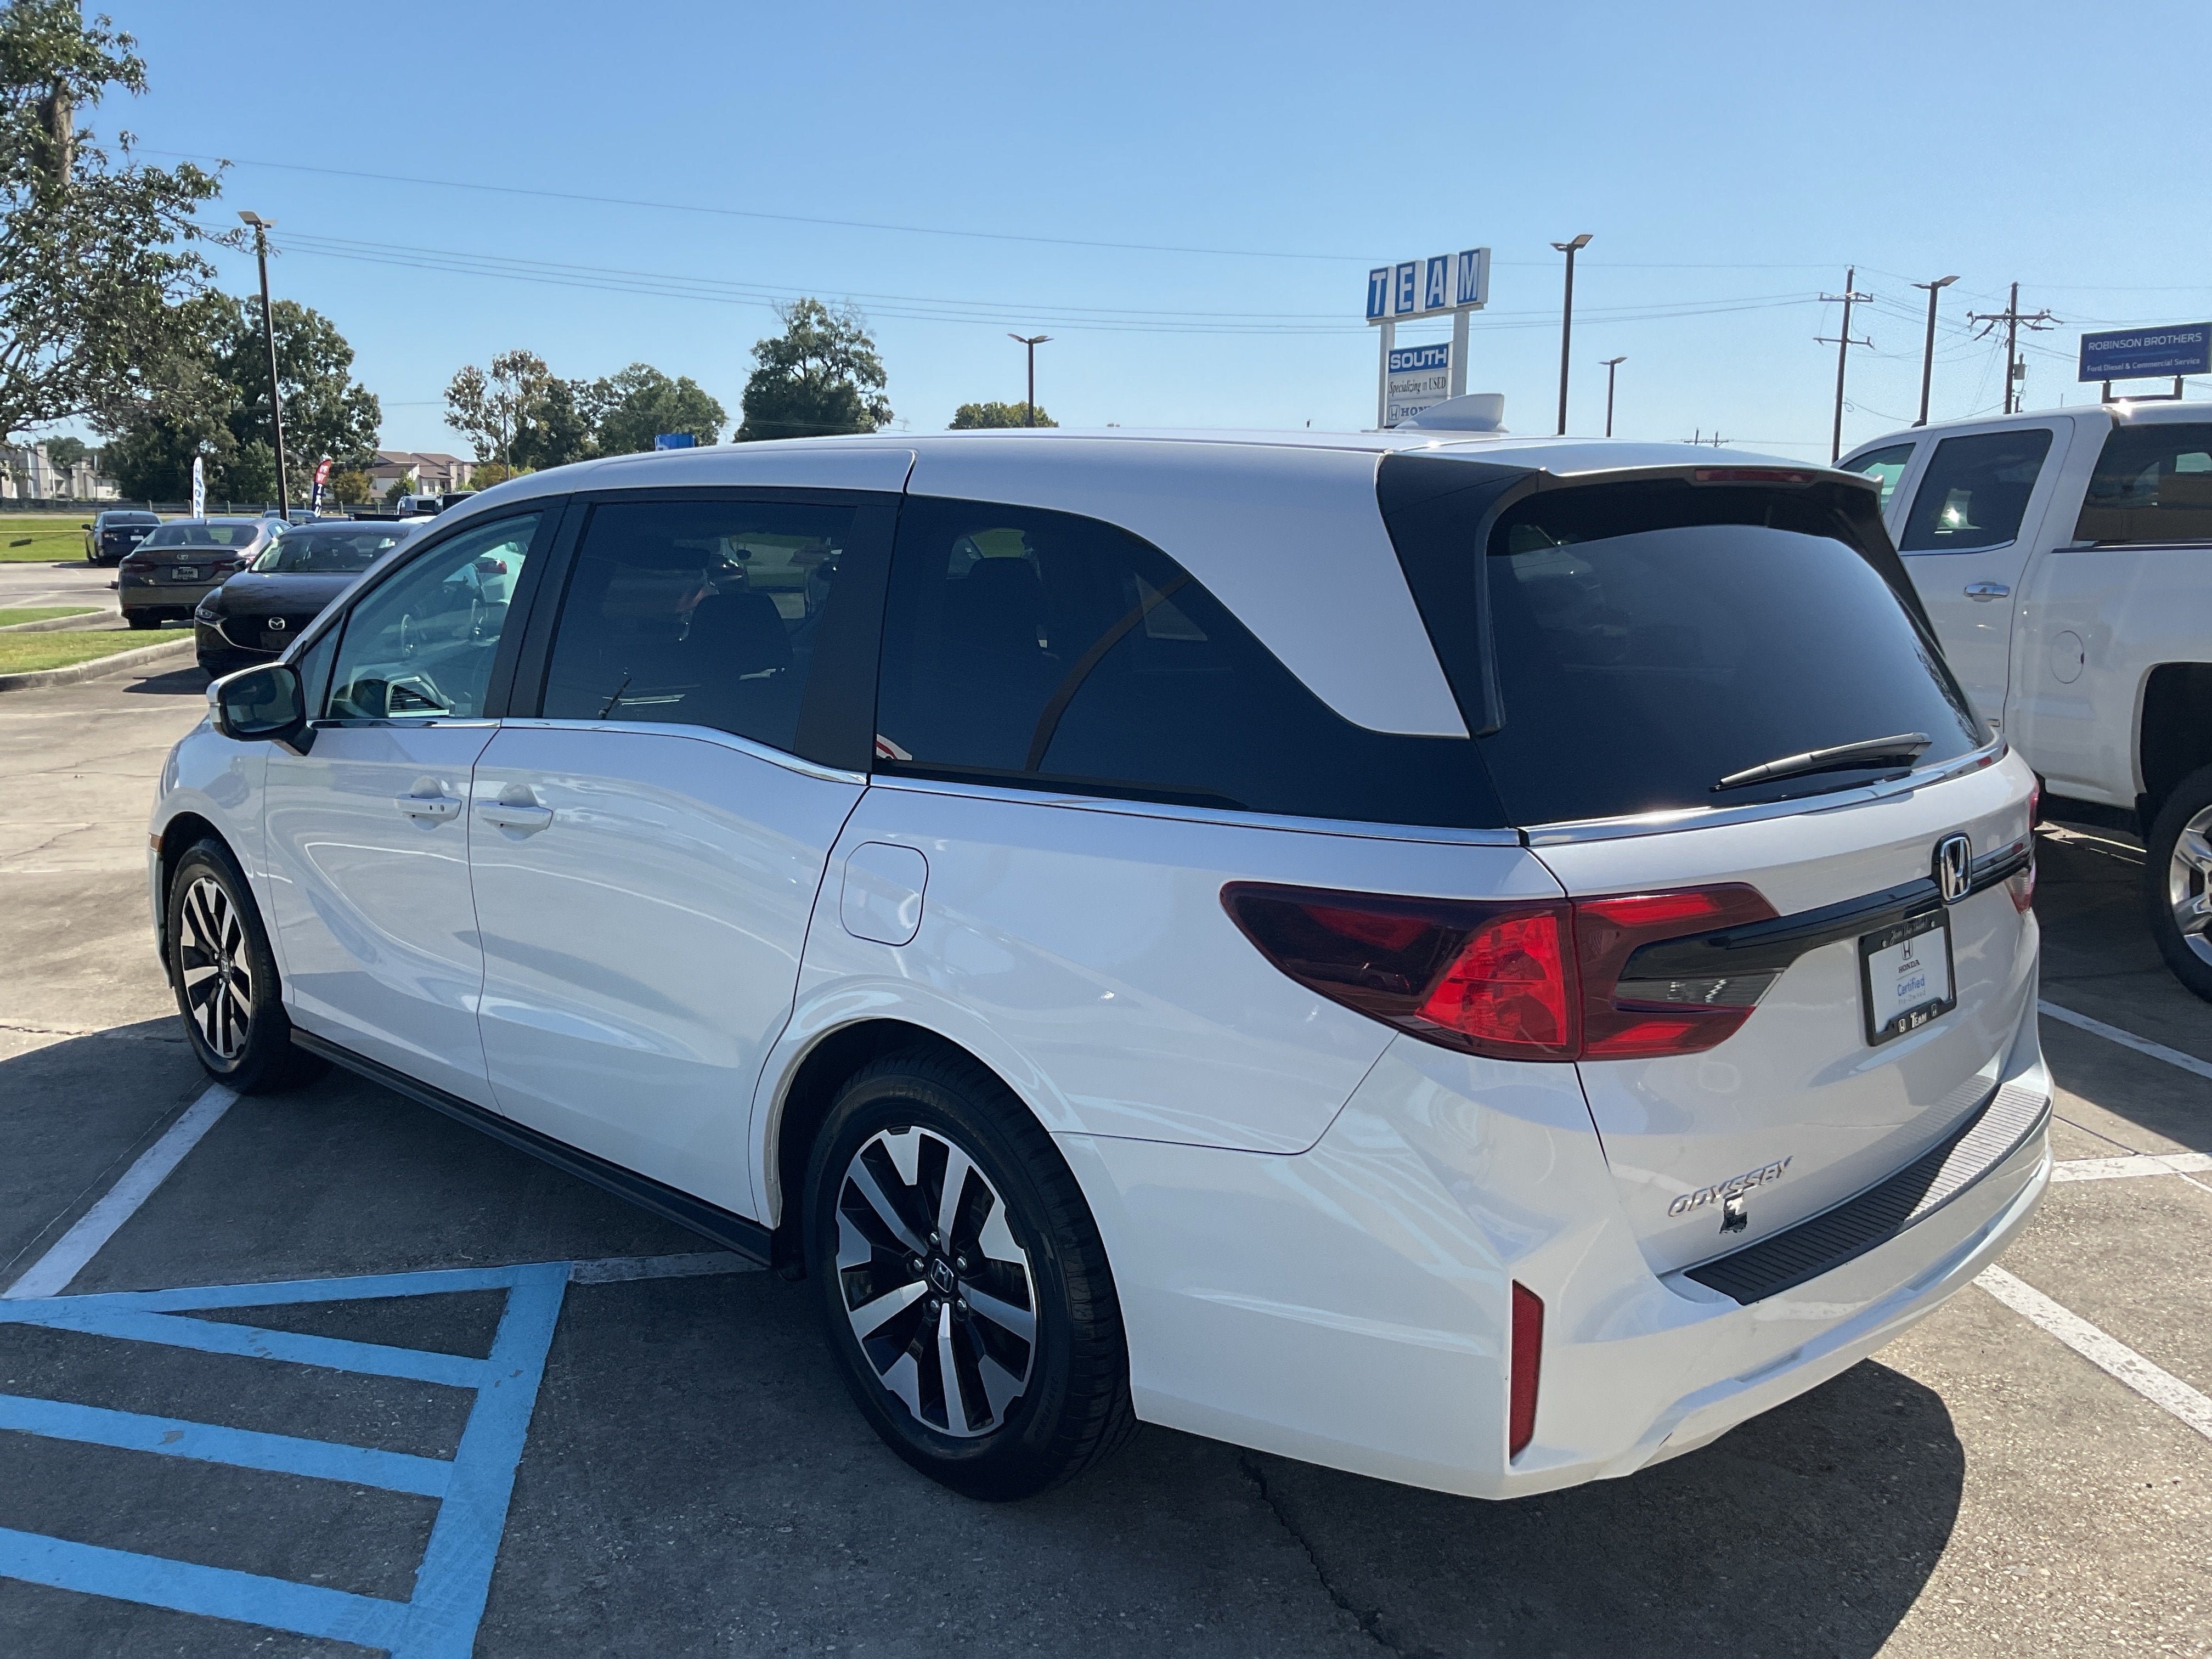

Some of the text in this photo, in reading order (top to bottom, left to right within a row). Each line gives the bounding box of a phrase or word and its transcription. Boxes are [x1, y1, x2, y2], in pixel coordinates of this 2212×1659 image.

[1372, 253, 1479, 314] TEAM
[2088, 332, 2202, 351] ROBINSON BROTHERS
[1390, 348, 1447, 369] SOUTH
[2103, 362, 2124, 371] Diesel
[2132, 359, 2172, 369] Commercial
[1389, 380, 1421, 397] Specializing
[1429, 377, 1446, 390] USED
[1898, 960, 1920, 973] HONDA
[1897, 974, 1925, 996] Certified
[1910, 1012, 1927, 1029] TEAM
[1668, 1155, 1793, 1217] ODYSSEY
